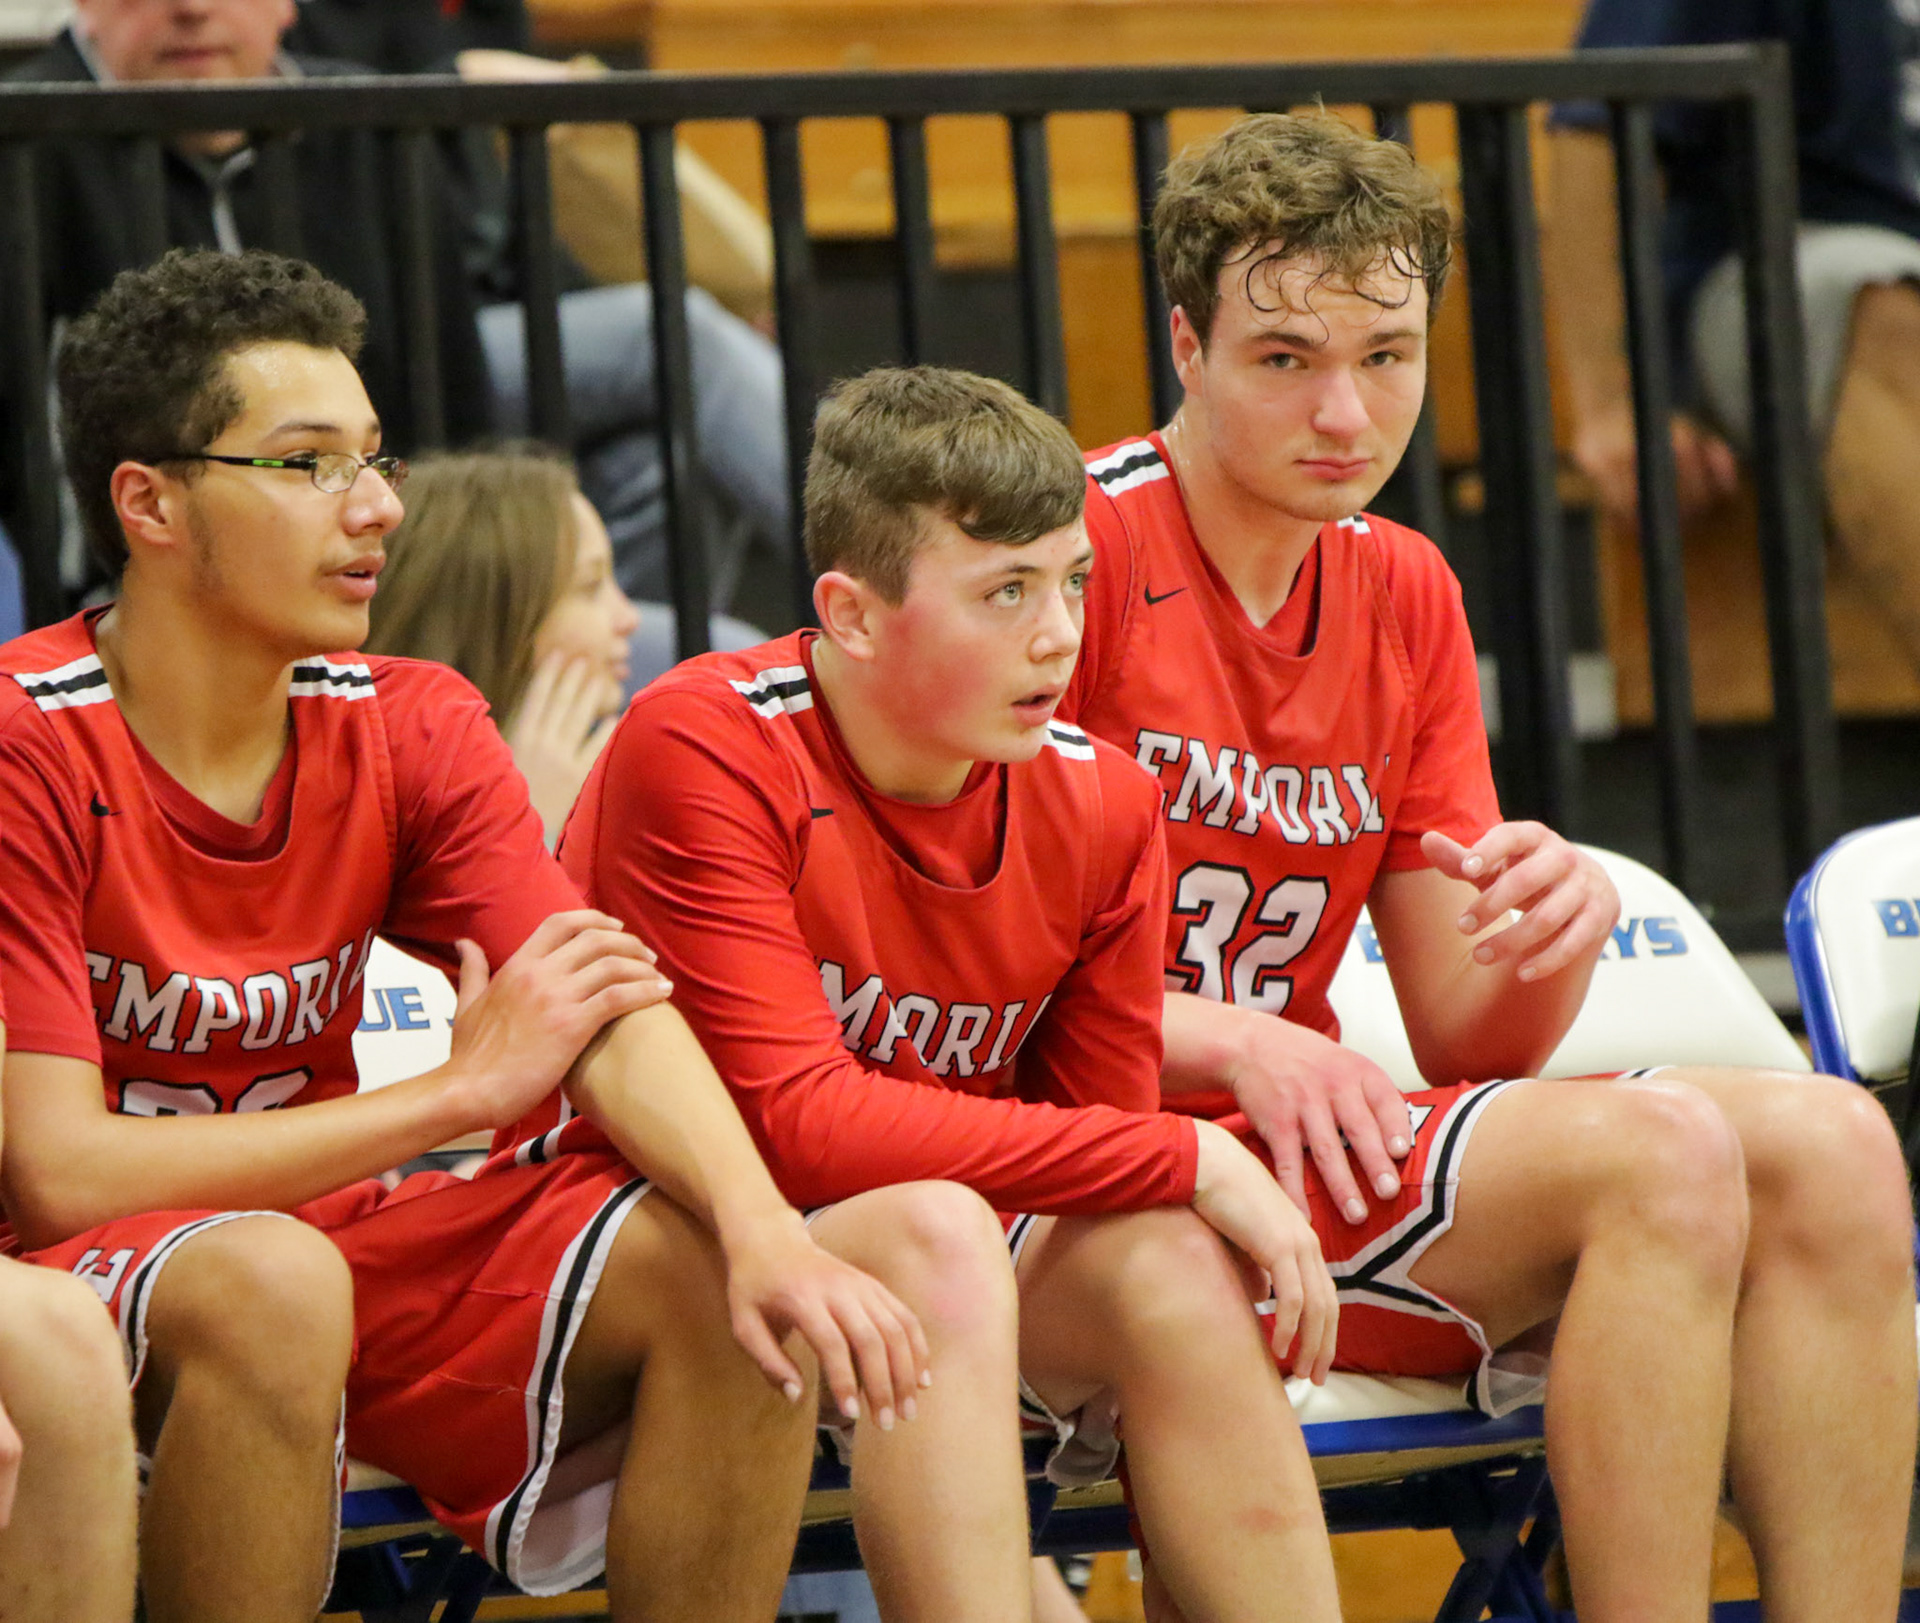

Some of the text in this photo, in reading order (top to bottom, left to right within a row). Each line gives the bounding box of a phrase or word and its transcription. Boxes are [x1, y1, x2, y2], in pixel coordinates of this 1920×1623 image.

[1165, 860, 1330, 1016] 32
[1600, 916, 1689, 960] YS
[815, 955, 1054, 1078] MPORI
